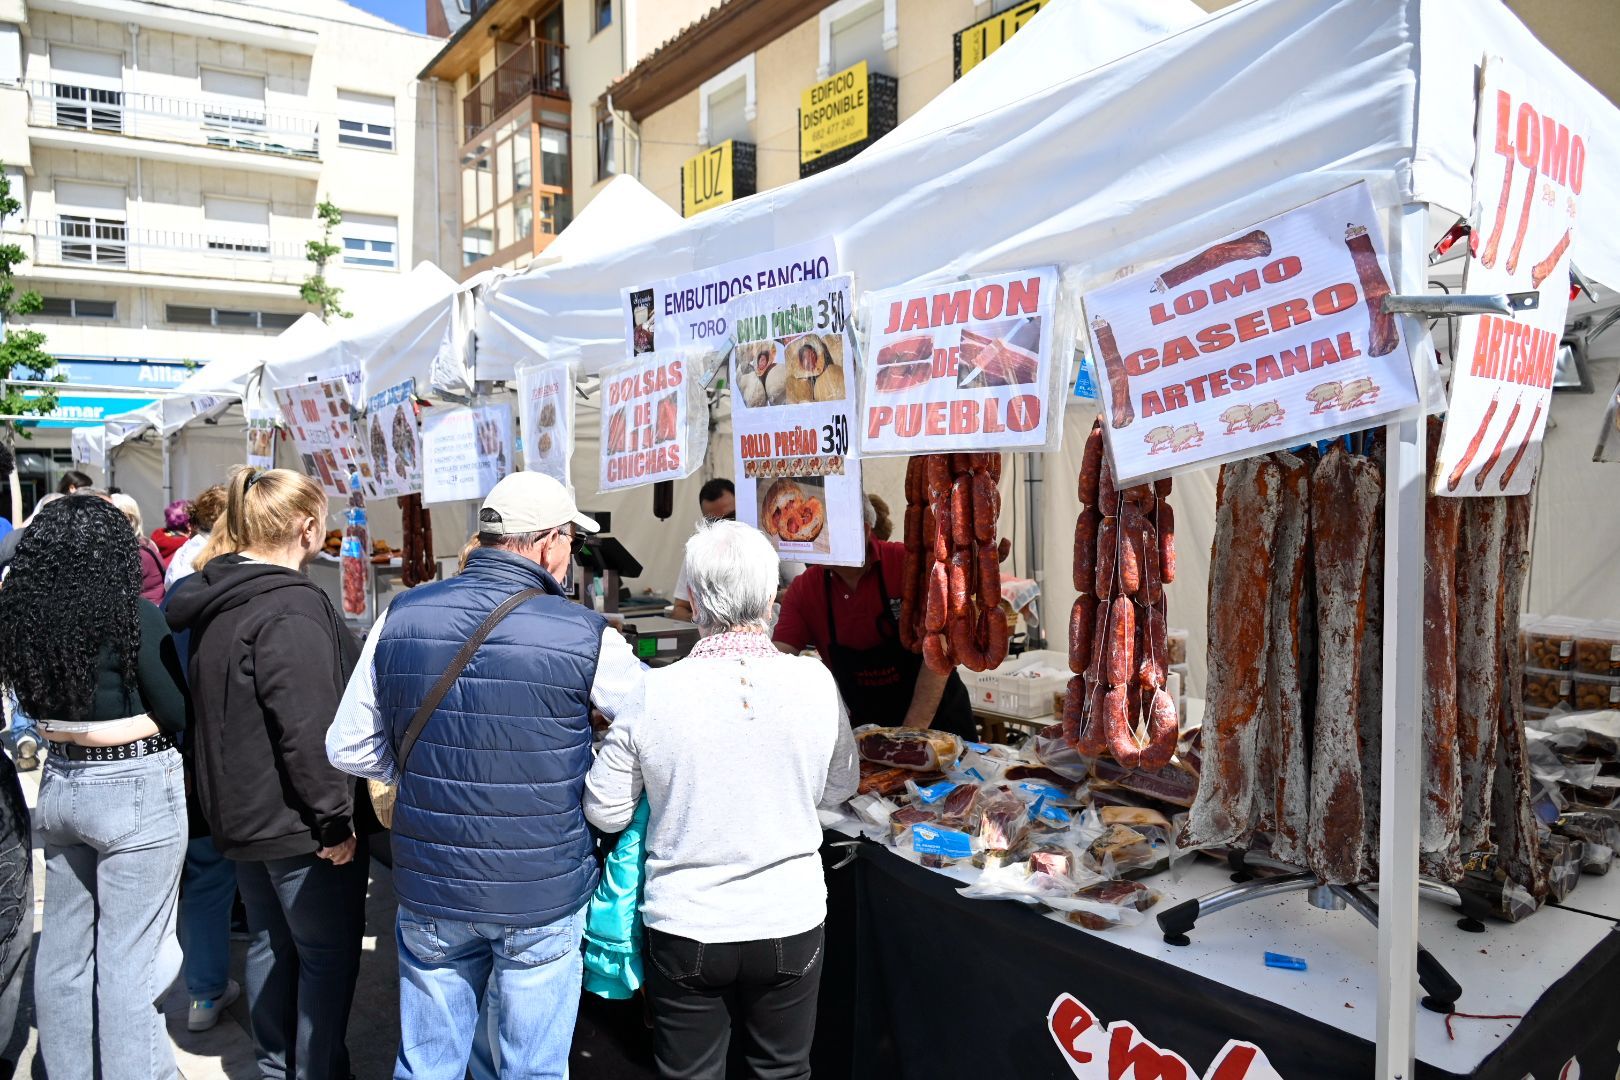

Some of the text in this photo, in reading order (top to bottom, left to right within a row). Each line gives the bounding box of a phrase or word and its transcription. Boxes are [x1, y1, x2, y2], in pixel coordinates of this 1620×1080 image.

[803, 89, 864, 130] DISPONIBLE
[811, 72, 854, 105] EDIFICIO
[1495, 89, 1585, 195] LOMO
[694, 147, 723, 204] LUZ
[664, 275, 752, 316] EMBUTIDOS
[757, 256, 830, 290] FANCHO
[884, 277, 1041, 334] JAMON
[1149, 256, 1303, 325] LOMO
[689, 317, 727, 340] TORO
[737, 314, 768, 344] BOLLO
[771, 303, 814, 338] PREÑAO
[1124, 282, 1359, 377] CASERO
[609, 361, 682, 406] BOLSAS
[932, 347, 960, 379] DE
[1141, 332, 1361, 418] ARTESANAL
[634, 401, 651, 428] DE
[741, 414, 849, 458] BOLLO PREÑAO 3'50
[868, 394, 1041, 439] PUEBLO
[607, 444, 680, 483] CHICHAS
